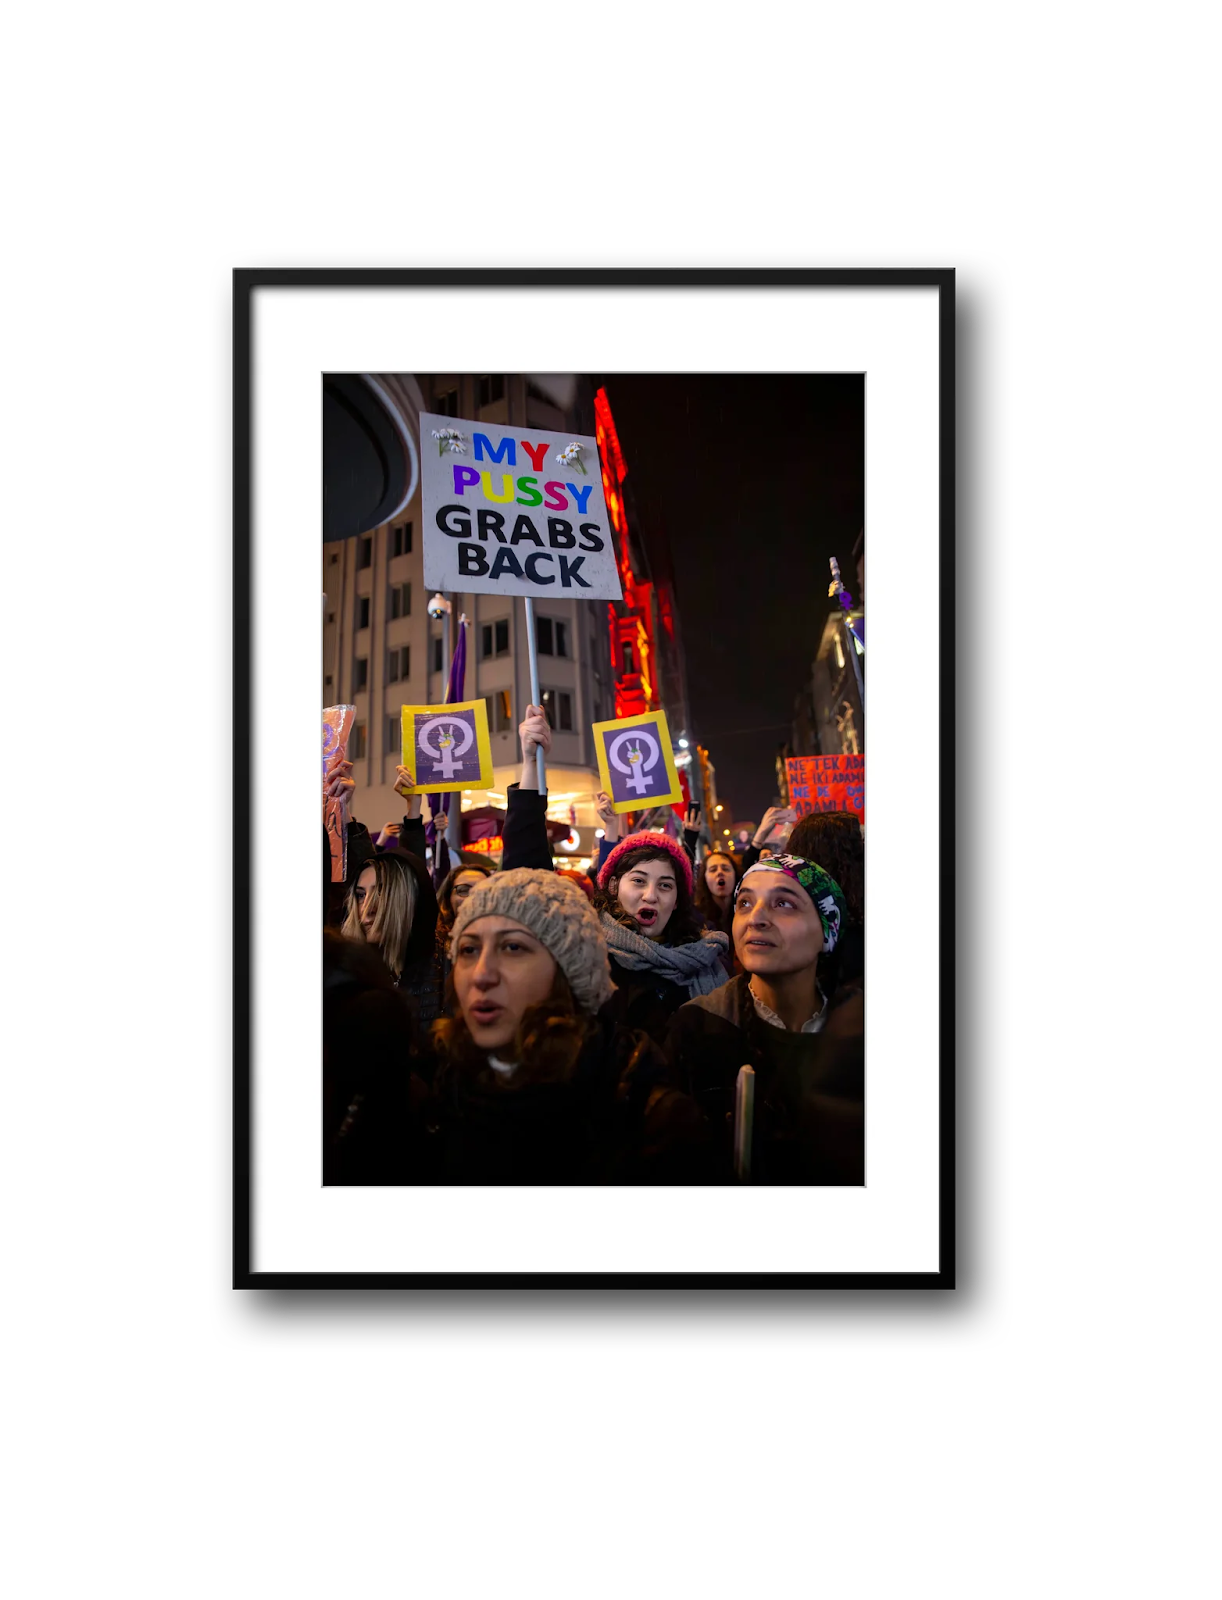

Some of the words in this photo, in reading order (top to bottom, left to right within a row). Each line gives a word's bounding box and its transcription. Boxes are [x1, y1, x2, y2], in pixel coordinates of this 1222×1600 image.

[472, 432, 550, 472] MY
[453, 464, 593, 515] PUSSY
[435, 504, 605, 553] GRABS
[457, 542, 593, 588] BACK
[788, 760, 807, 771] NE
[811, 757, 840, 771] TEK
[789, 772, 808, 784] NE
[793, 786, 811, 799] NE
[817, 785, 831, 797] DE
